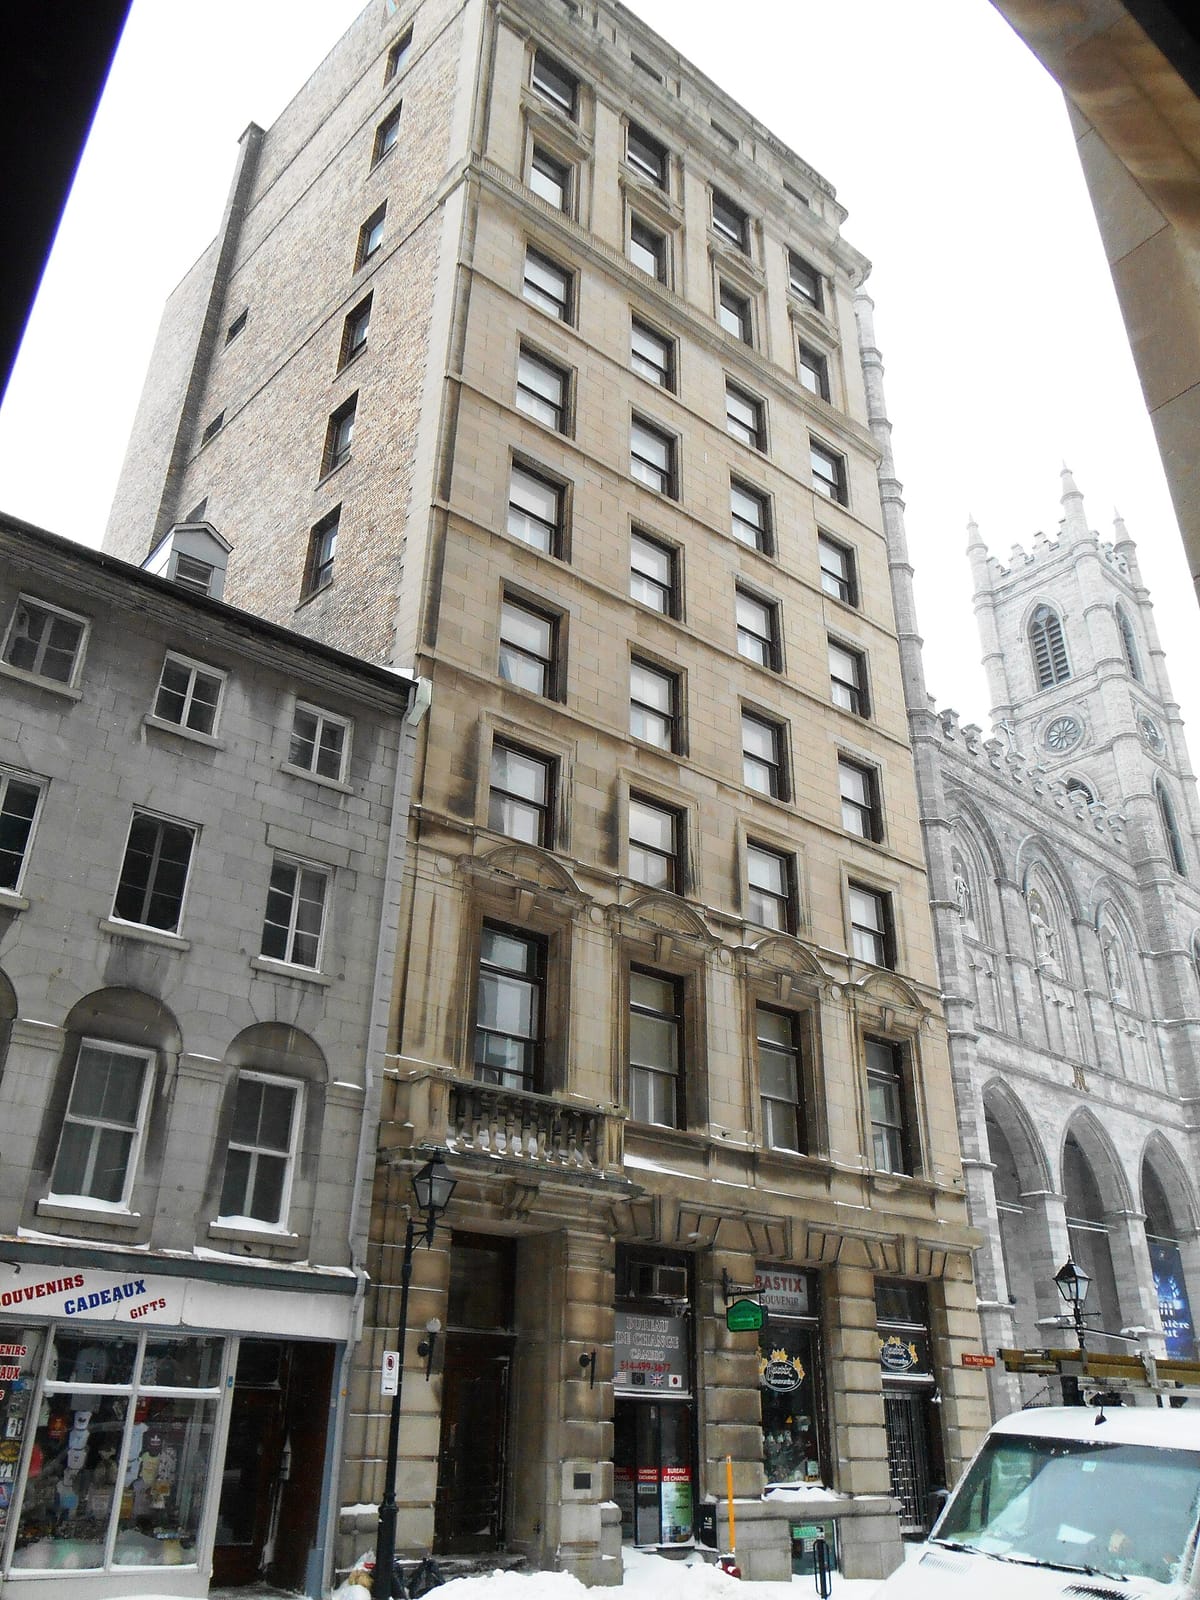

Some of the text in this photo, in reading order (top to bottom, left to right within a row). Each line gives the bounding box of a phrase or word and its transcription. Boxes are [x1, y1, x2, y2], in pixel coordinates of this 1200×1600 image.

[0, 1274, 84, 1306] OUVENIRS
[755, 1275, 803, 1293] BASTIX
[64, 1279, 147, 1315] CADEAUX
[130, 1298, 166, 1319] GIFTS
[0, 1345, 27, 1356] ENIRS
[0, 1366, 20, 1380] AUX
